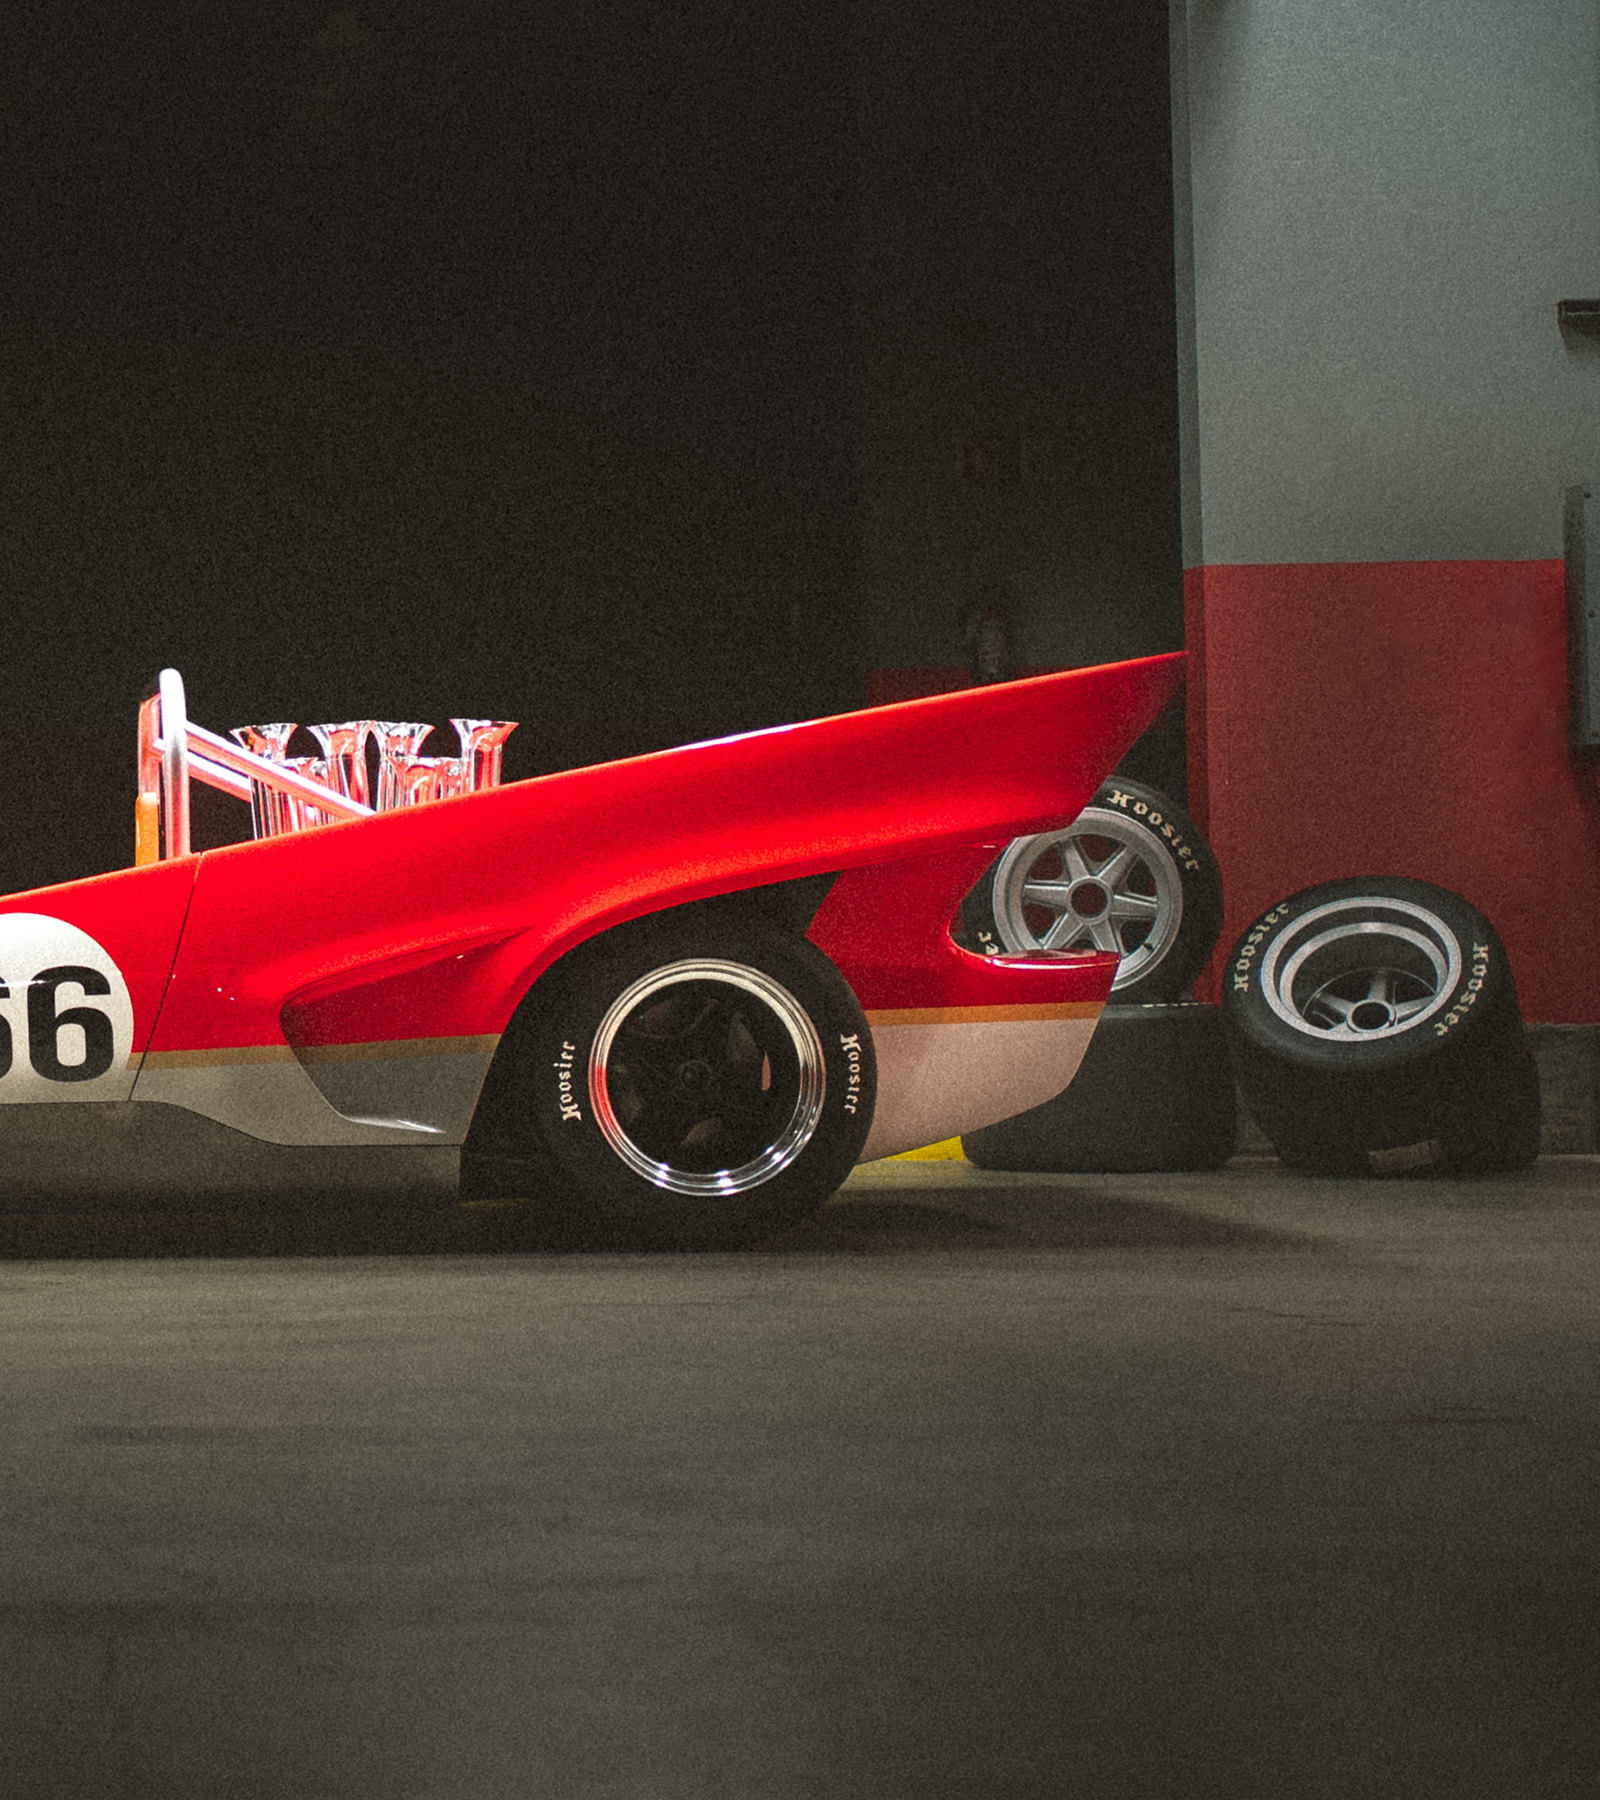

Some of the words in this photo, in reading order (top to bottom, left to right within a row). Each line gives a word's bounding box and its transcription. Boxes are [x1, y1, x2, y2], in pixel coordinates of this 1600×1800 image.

[1106, 789, 1198, 872] Hoosier
[1234, 903, 1289, 992] Hoosier
[1435, 941, 1488, 1037] Hoosier
[553, 1040, 582, 1121] Hoosier
[840, 1033, 862, 1114] Hoosier
